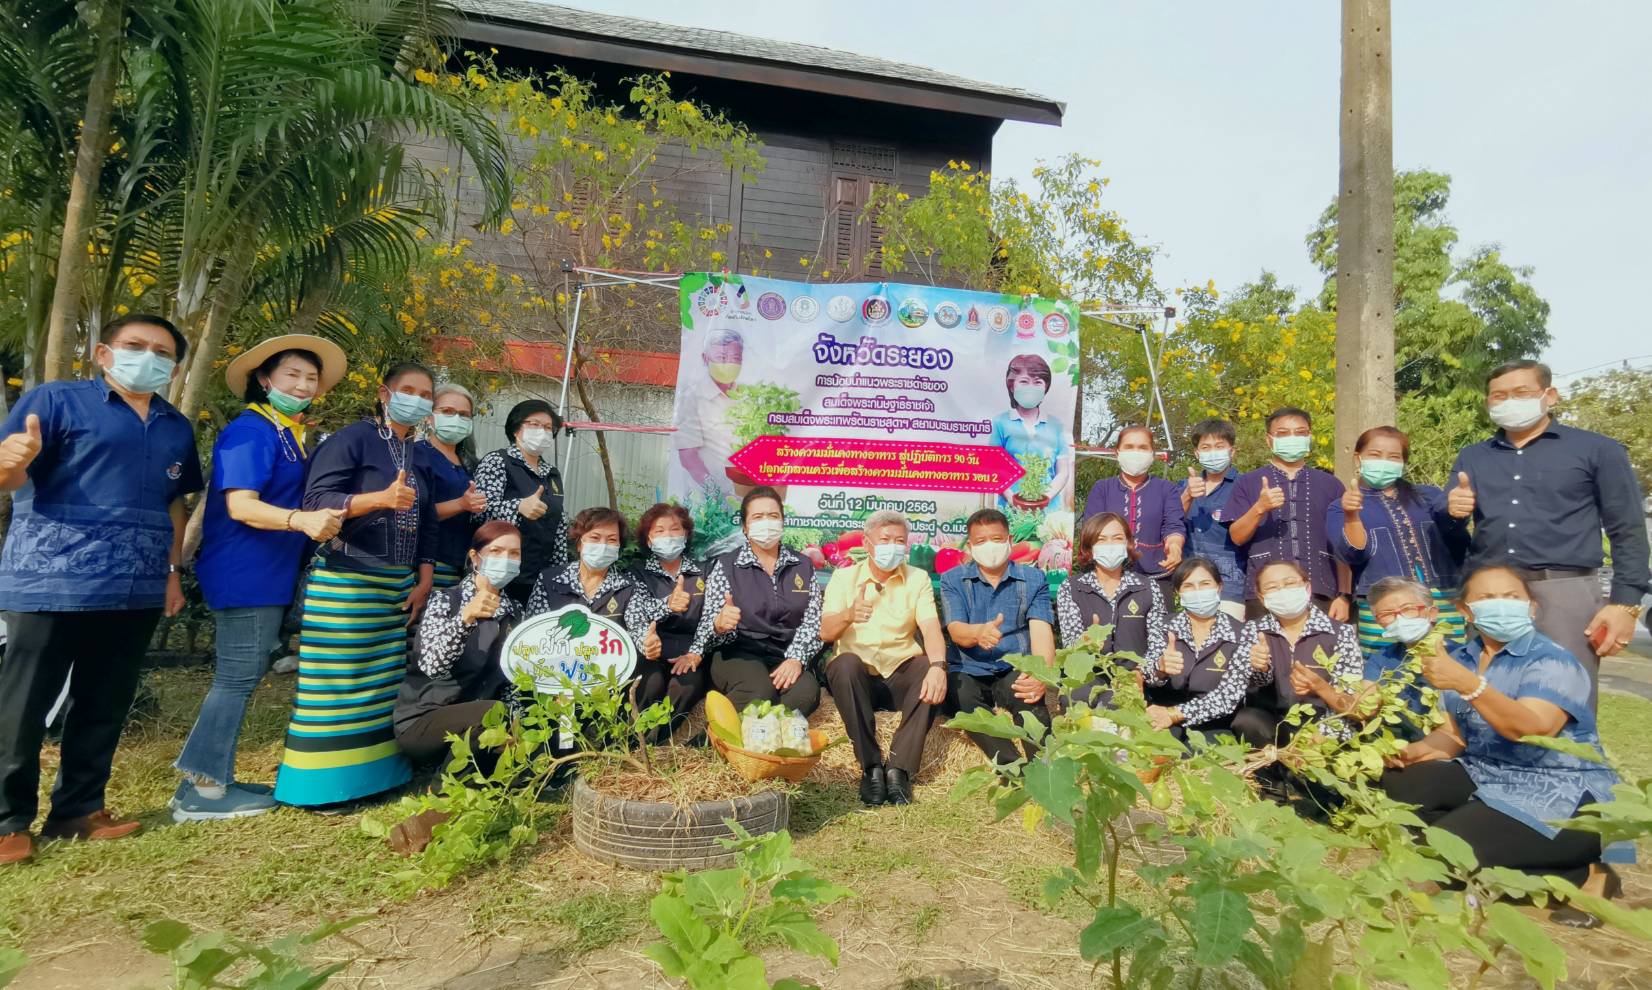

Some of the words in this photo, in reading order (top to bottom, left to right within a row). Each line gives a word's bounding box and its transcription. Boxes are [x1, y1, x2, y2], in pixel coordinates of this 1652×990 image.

[814, 333, 953, 369] จังหวัดระยอง
[816, 372, 948, 392] การน้อมนำแนวพระราชดำริของ
[822, 393, 935, 413] สมเด็จพระกนิษฐาธิราชเจ้า
[911, 419, 993, 438] สยามบรมราชกุมารี
[776, 445, 897, 461] สร้างความมั่นคงทางอาหาร
[898, 449, 951, 466] สู่ปฏิบัติการ
[953, 455, 965, 464] 90
[966, 454, 980, 465] วัน
[758, 461, 971, 482] ปลูกผักสวนครัวเพื่อสร้างความมั่นคงทางอาหาร
[972, 472, 990, 482] รอบ
[990, 473, 999, 483] 2
[818, 493, 845, 511] วันที่
[847, 499, 863, 511] 12
[865, 497, 904, 513] มีนาคม
[904, 500, 937, 514] 2564
